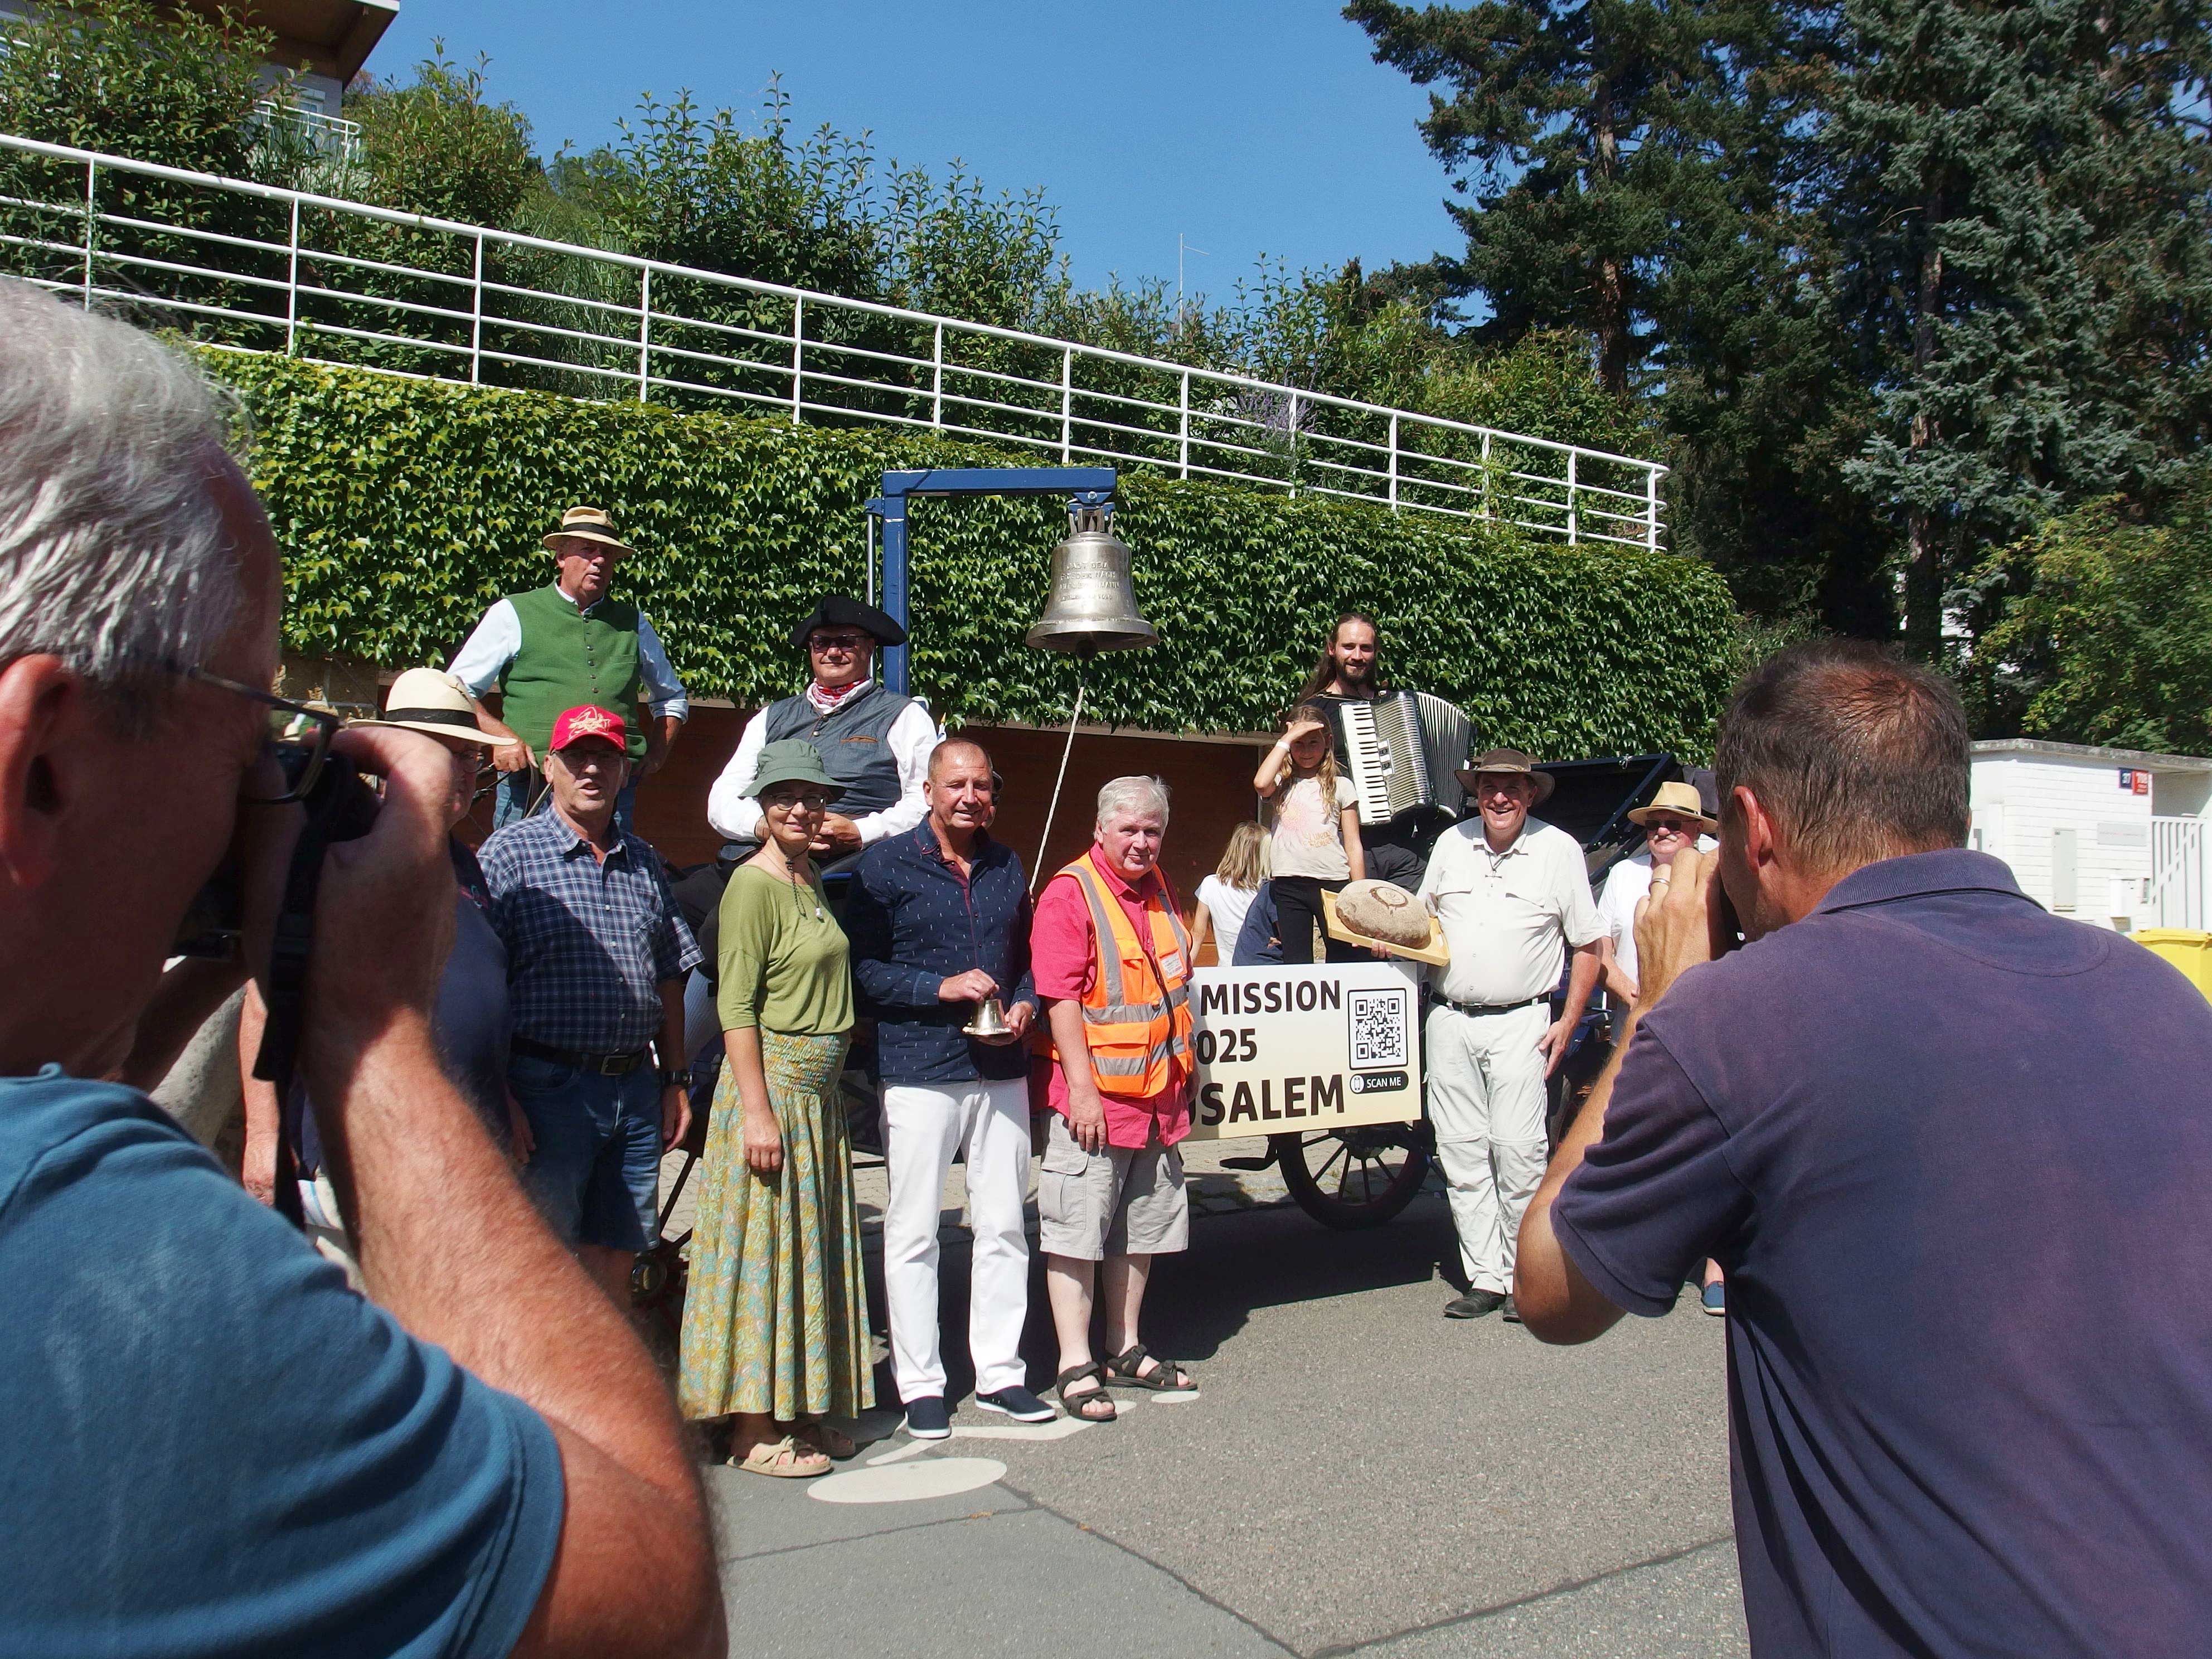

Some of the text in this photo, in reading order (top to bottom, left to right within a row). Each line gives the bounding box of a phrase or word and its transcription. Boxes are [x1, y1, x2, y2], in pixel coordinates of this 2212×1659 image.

[1201, 980, 1340, 1016] MISSION
[1197, 1029, 1257, 1065] 025
[1367, 1076, 1401, 1088] SCAN ME
